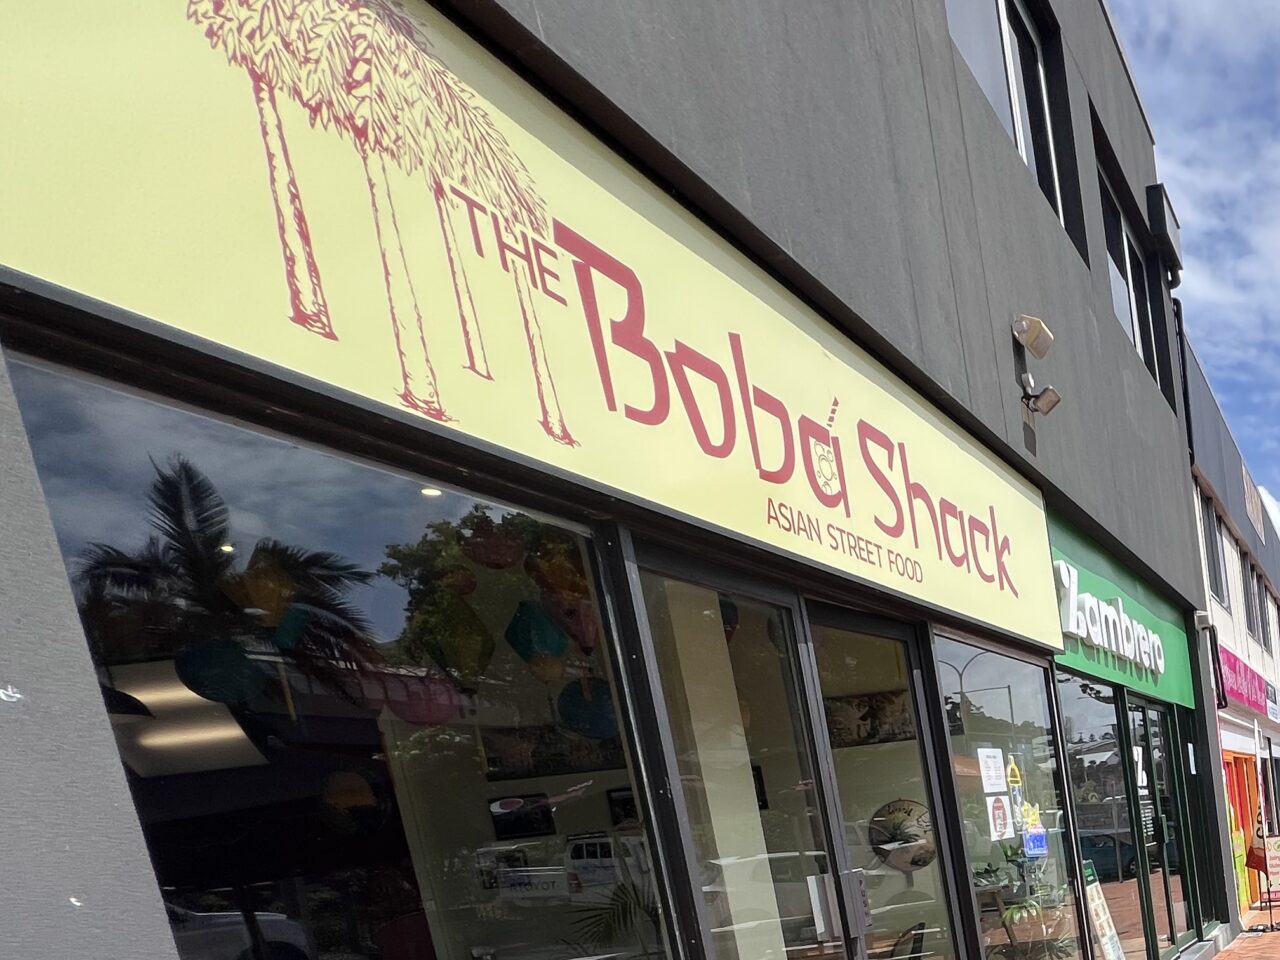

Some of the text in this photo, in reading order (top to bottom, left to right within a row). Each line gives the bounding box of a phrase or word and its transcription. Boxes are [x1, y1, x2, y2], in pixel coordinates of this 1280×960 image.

[450, 186, 568, 307] THE
[552, 217, 1018, 598] Boba Shack
[767, 497, 923, 583] ASIAN STREET FOOD
